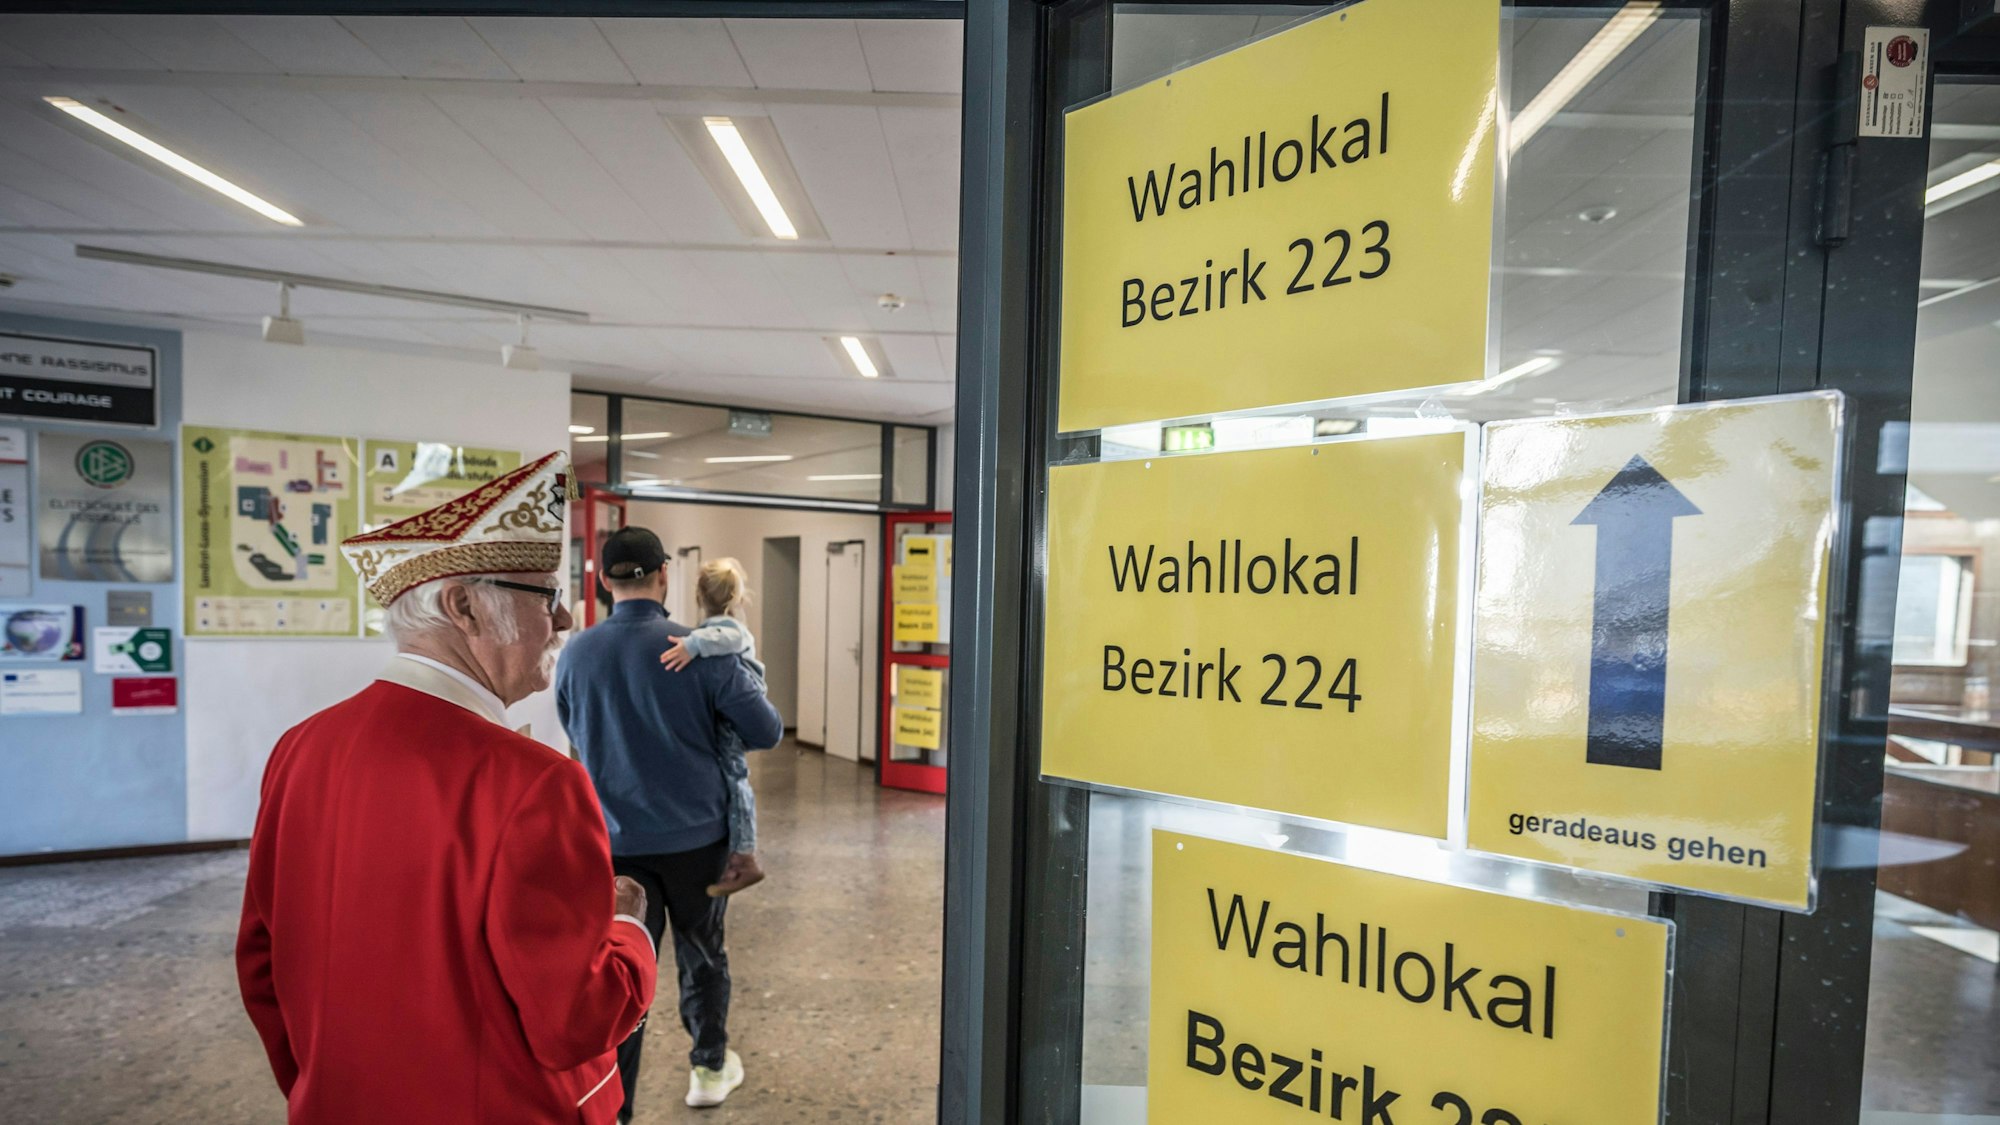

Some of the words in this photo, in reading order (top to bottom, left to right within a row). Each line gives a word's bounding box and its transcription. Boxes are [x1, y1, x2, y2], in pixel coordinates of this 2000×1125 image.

[1128, 92, 1389, 222] Wahllokal
[1122, 249, 1267, 328] Bezirk
[1287, 220, 1391, 295] 223
[41, 355, 148, 376] RASSISMUS
[22, 389, 112, 408] COURAGE
[381, 453, 395, 468] A
[1108, 536, 1359, 595] Wahllokal
[1103, 645, 1242, 703] Bezirk
[1260, 653, 1362, 713] 224
[1509, 813, 1657, 850] geradeaus
[1667, 836, 1767, 869] gehen
[1207, 888, 1556, 1039] Wahllokal
[1186, 1009, 1402, 1125] Bezirk
